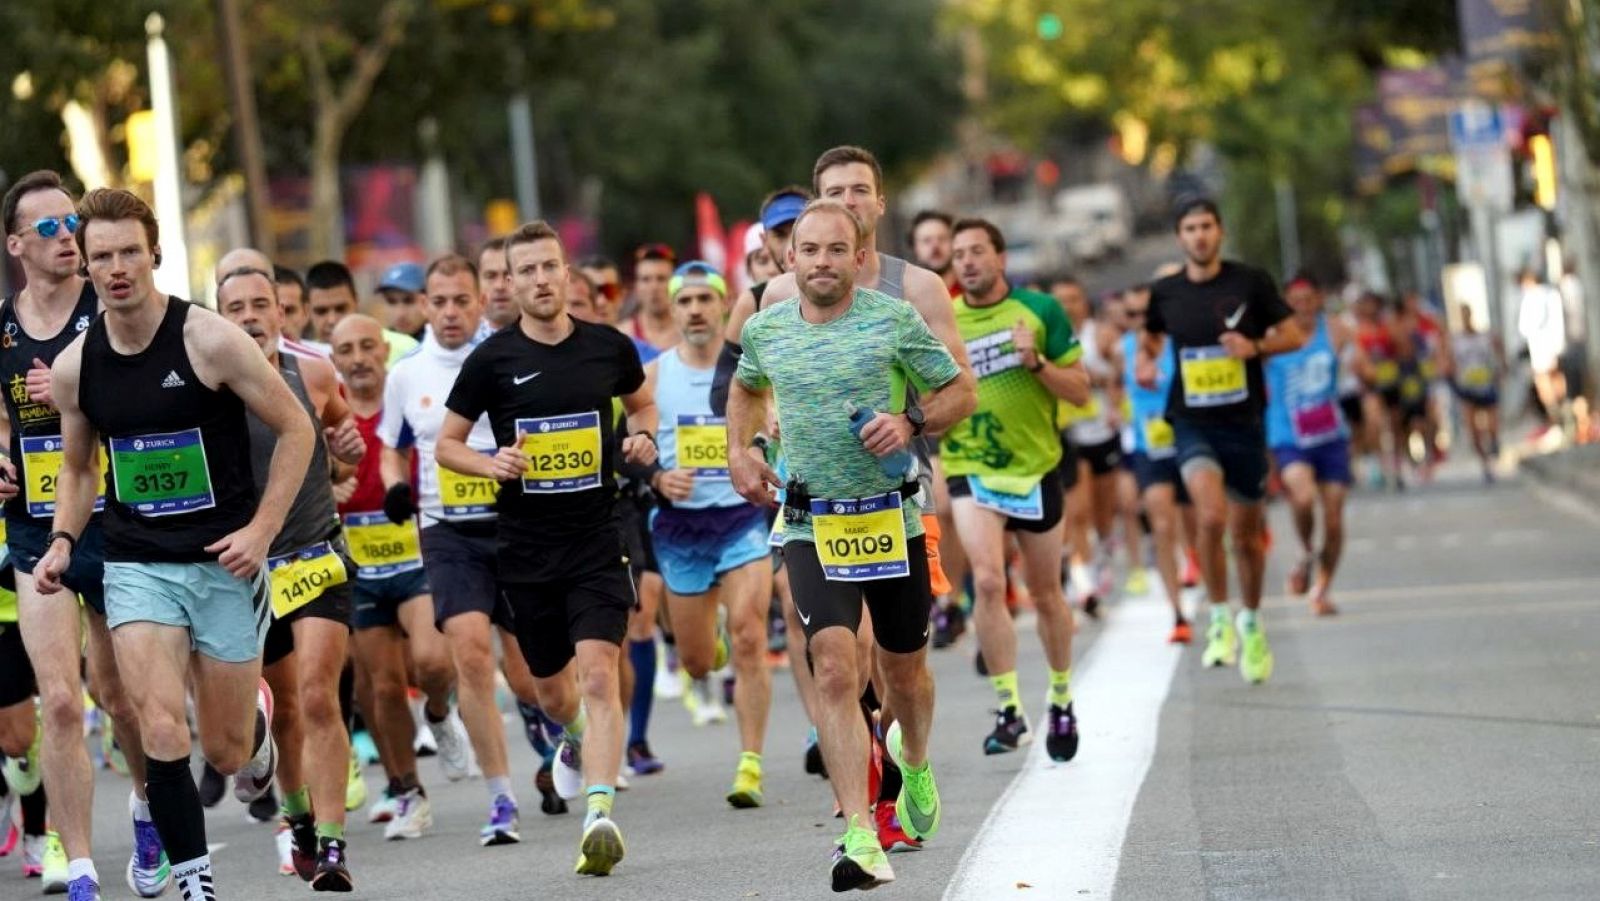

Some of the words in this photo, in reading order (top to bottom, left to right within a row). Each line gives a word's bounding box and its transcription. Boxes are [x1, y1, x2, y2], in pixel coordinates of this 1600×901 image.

[552, 421, 579, 429] ZURICH
[145, 439, 175, 448] ZURICH
[531, 450, 594, 472] 12330
[133, 471, 189, 494] 3137
[454, 481, 498, 498] 9711
[361, 542, 405, 558] 1888
[826, 534, 893, 557] 10109
[281, 567, 333, 604] 14101
